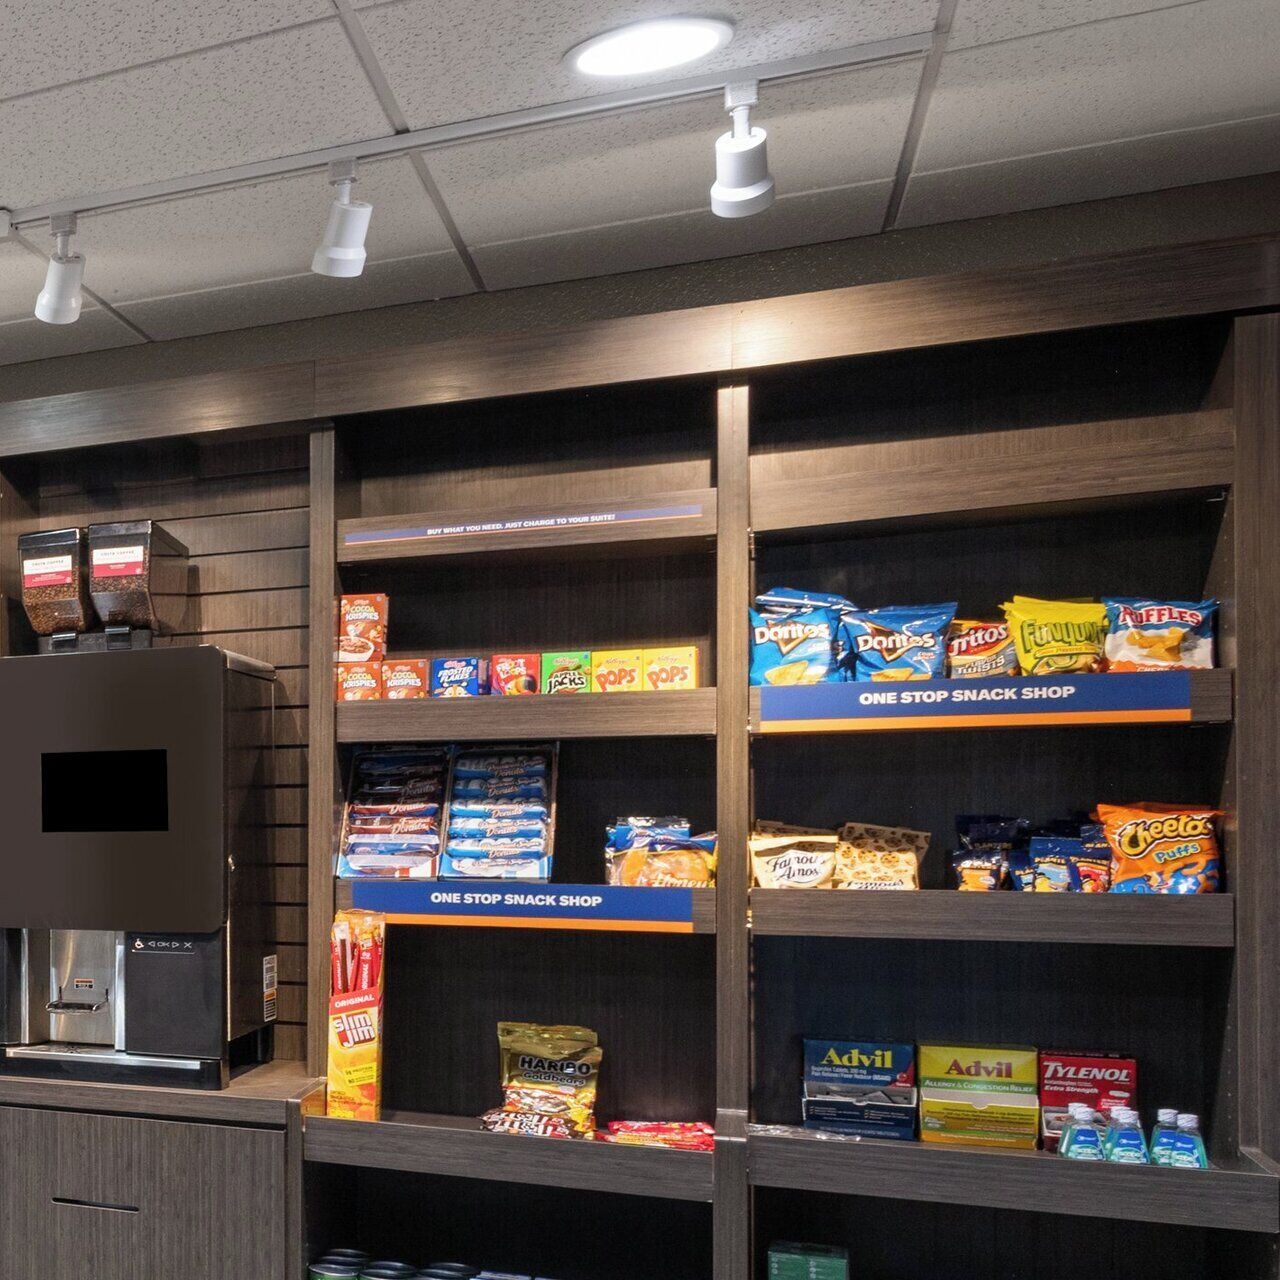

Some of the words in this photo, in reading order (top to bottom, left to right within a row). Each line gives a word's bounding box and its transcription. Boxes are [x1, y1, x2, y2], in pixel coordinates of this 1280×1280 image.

[345, 613, 379, 621] KRISPIES
[1120, 604, 1202, 625] RUFFLES
[754, 623, 830, 644] Doritos
[857, 633, 935, 651] Doritos
[438, 667, 472, 676] FROSTED
[441, 674, 468, 682] FLAKES
[596, 669, 636, 692] POPS
[647, 667, 688, 689] POPS
[343, 679, 377, 688] KRISPIES
[548, 676, 585, 693] JACKS
[859, 692, 897, 705] ONE
[900, 690, 948, 704] STOP
[951, 688, 1017, 702] SNACK
[1021, 685, 1075, 699] SHOP
[430, 892, 461, 904] ONE
[463, 893, 502, 905] STOP
[504, 894, 557, 907] SNACK
[559, 895, 602, 908] SHOP
[335, 994, 374, 1008] ORIGINAL
[520, 1056, 590, 1076] HARIBO
[820, 1048, 892, 1068] Advil
[946, 1059, 1012, 1078] Advil
[1043, 1061, 1130, 1081] TYLENOL
[523, 1072, 585, 1086] Goldbears
[1066, 1086, 1098, 1094] Strength
